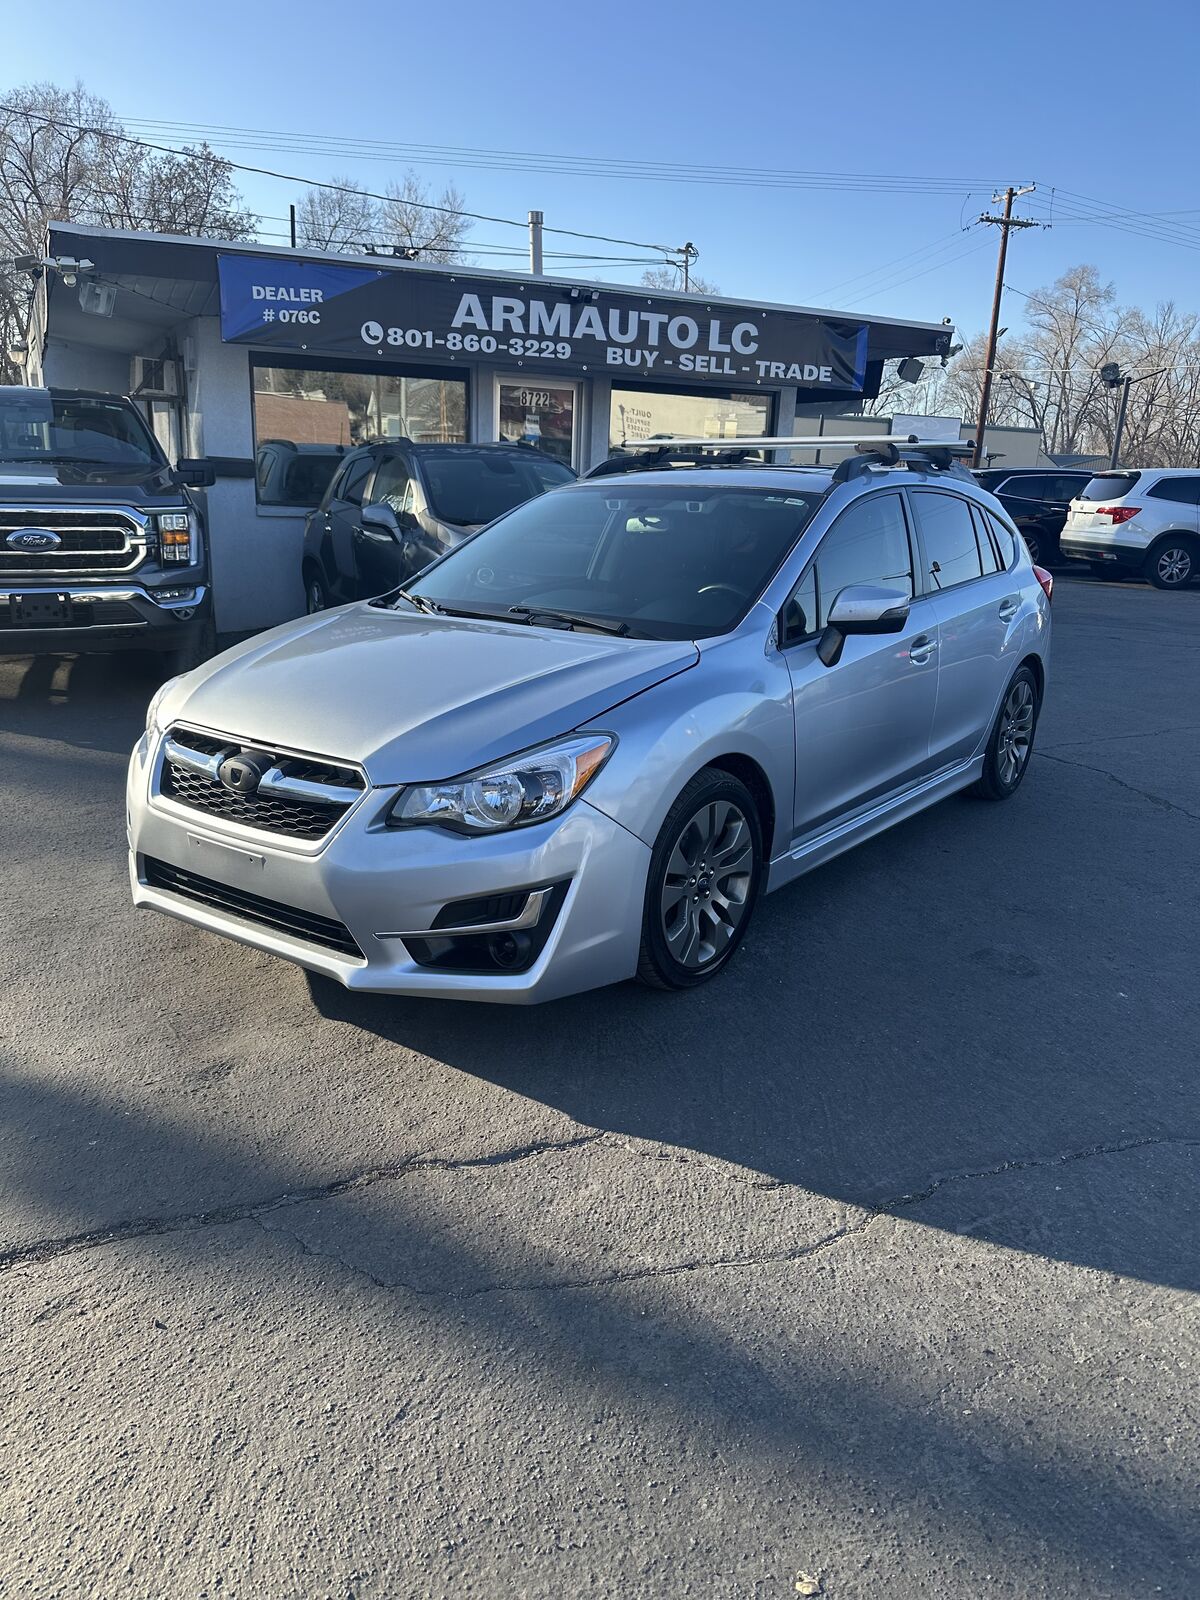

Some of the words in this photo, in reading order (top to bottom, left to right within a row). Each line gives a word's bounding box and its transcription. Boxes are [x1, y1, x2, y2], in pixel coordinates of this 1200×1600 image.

[252, 285, 324, 303] DEALER
[262, 309, 275, 323] #
[279, 310, 321, 325] 076C
[451, 293, 699, 349] ARMAUTO
[708, 319, 759, 355] LC
[386, 327, 572, 360] 801-860-3229
[606, 346, 660, 368] BUY
[678, 353, 737, 375] SELL
[755, 360, 833, 382] TRADE
[521, 391, 549, 407] 8722
[21, 534, 48, 546] Ford
